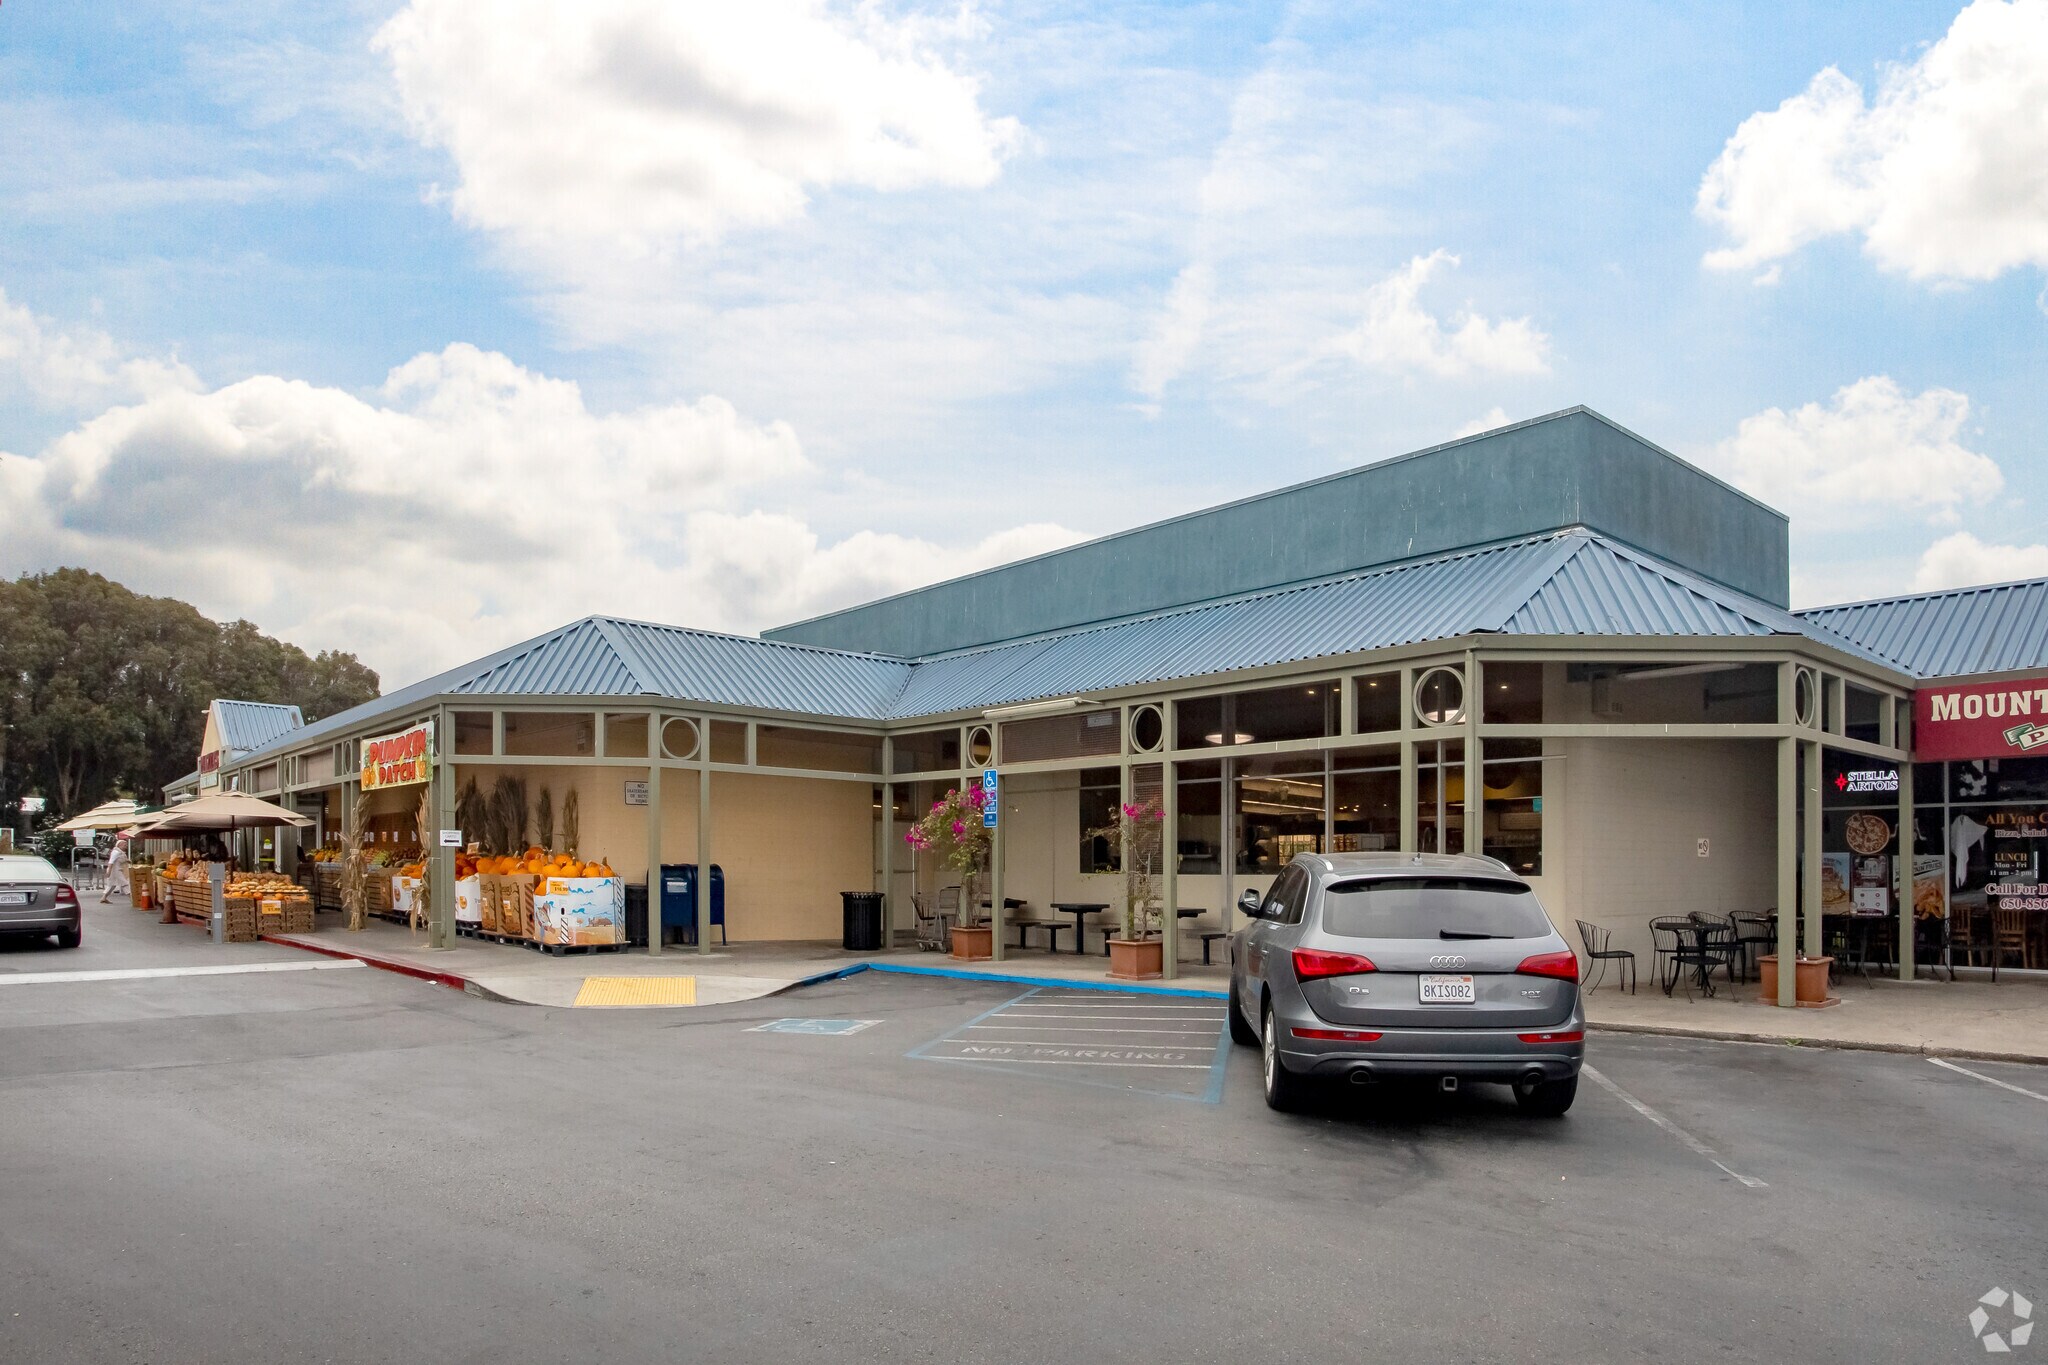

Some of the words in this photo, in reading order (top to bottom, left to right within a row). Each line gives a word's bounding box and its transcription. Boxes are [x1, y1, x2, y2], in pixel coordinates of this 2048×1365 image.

[369, 728, 427, 766] PUMPKIN
[379, 761, 416, 785] PATCH
[1847, 770, 1899, 781] STELLA
[1846, 780, 1899, 791] ARTOIS
[1985, 813, 2005, 824] All
[2009, 812, 2035, 824] You
[2021, 828, 2047, 838] Salad
[1994, 852, 2028, 862] LUNCH
[1984, 882, 2011, 895] Call
[2012, 882, 2038, 895] For
[1424, 985, 1471, 998] 8KIS082
[961, 1046, 1012, 1054] NO
[1034, 1048, 1187, 1060] PARKING
